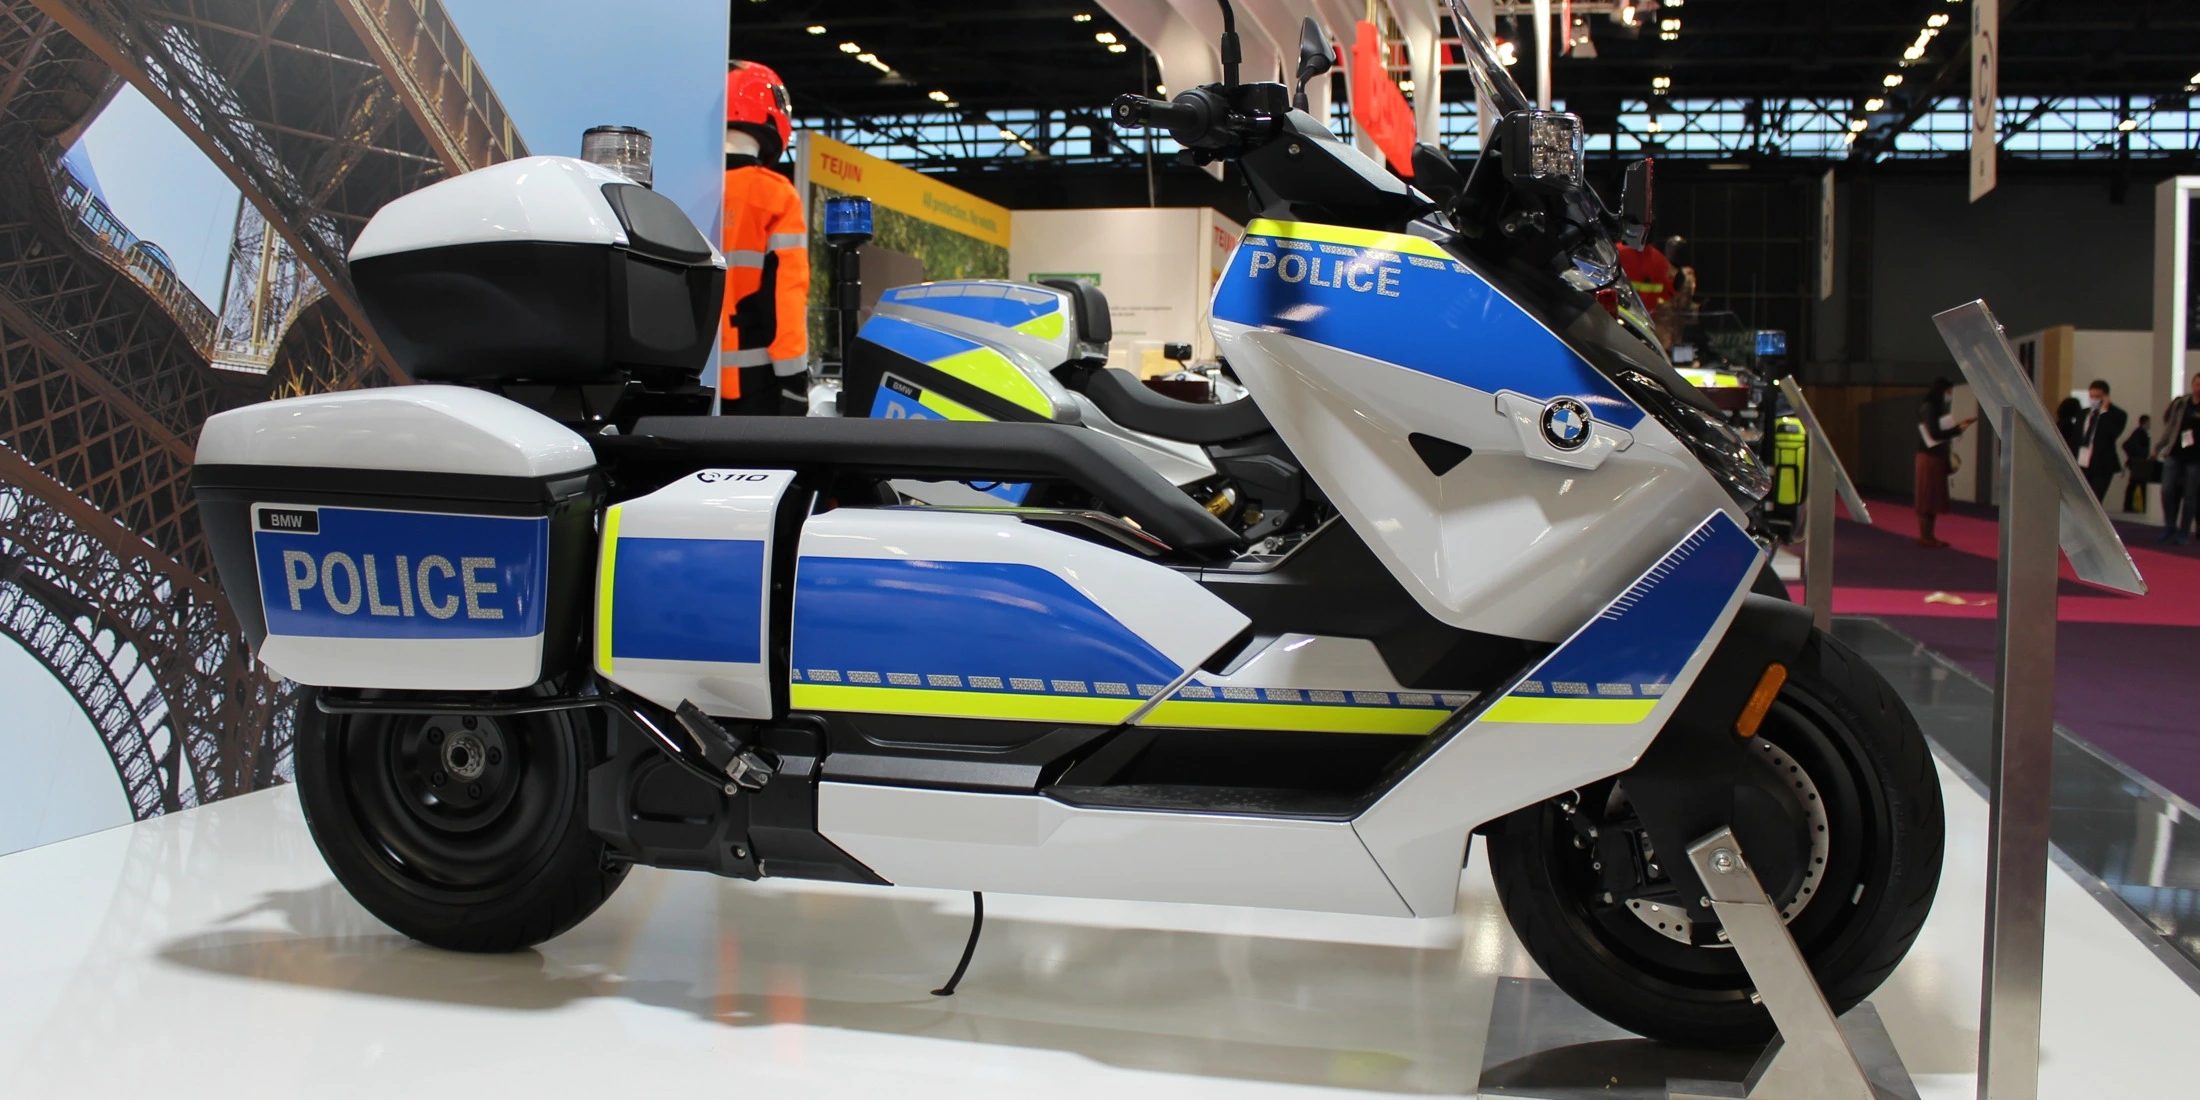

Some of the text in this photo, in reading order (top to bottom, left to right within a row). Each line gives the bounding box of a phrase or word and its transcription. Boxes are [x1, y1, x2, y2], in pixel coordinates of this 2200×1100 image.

[820, 152, 863, 183] TEIJIN
[1249, 250, 1401, 297] POLICE
[892, 381, 912, 396] BMW
[723, 474, 769, 482] 110
[271, 514, 302, 528] BMW
[283, 550, 504, 619] POLICE
